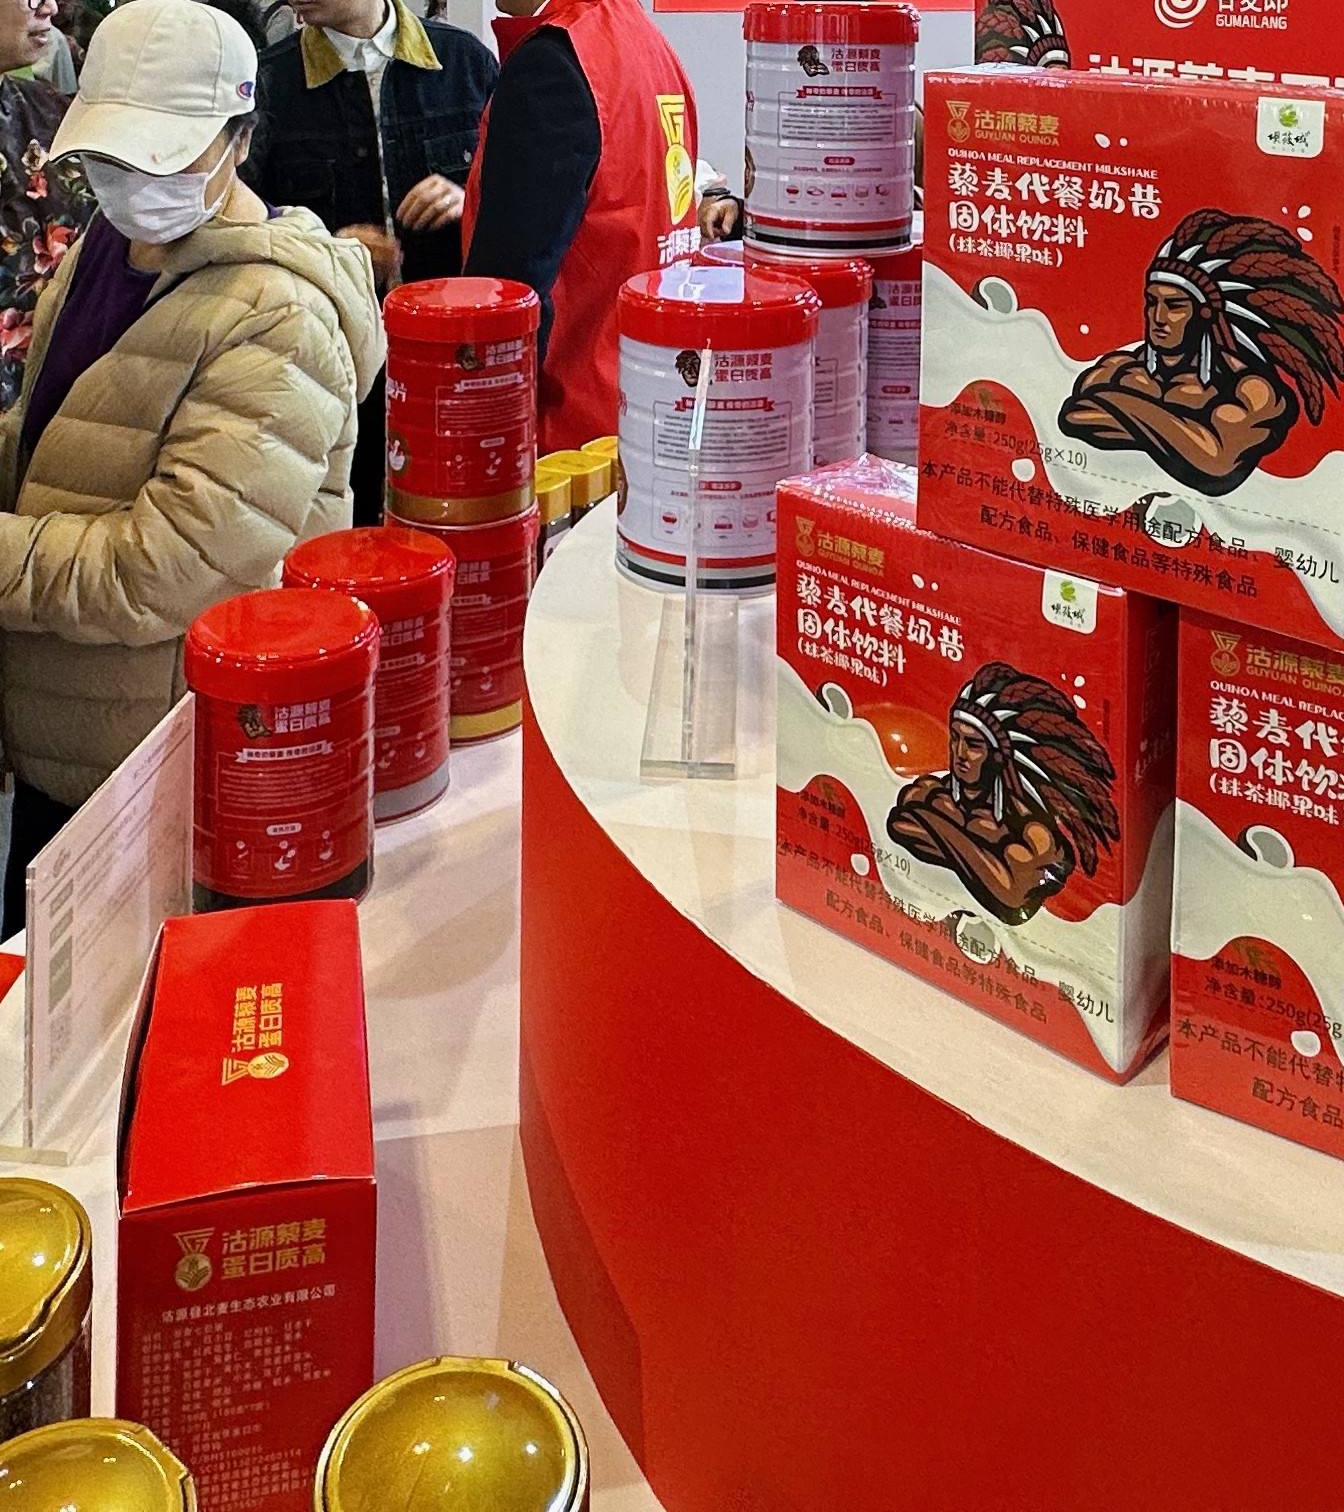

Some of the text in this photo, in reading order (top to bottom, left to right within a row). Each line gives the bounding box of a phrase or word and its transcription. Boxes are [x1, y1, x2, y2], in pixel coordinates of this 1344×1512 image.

[1215, 14, 1288, 30] GUMAILANG
[974, 109, 1060, 135] 沽源藜麦
[987, 152, 1015, 165] MEAL
[1017, 156, 1093, 173] REPLACEMENT
[1095, 164, 1159, 180] MILKSHAKE
[947, 162, 1163, 219] 藜麦代餐奶昔
[948, 200, 1089, 248] 固体饮料
[921, 460, 1339, 585] 本产品不能代替特殊医学用途配方食品、婴幼儿
[980, 504, 1257, 598] 配方食品、保健食品等特殊食品
[796, 572, 964, 662] 藜麦代餐奶昔
[797, 608, 906, 674] 固体饮料
[1210, 679, 1258, 699] QUINOA
[1260, 690, 1296, 709] MEAL
[1245, 665, 1298, 686] GUYUAN
[258, 983, 283, 1049] 蛋白质高
[221, 1218, 327, 1255] 沽源藜麦
[221, 1245, 326, 1281] 蛋白质高
